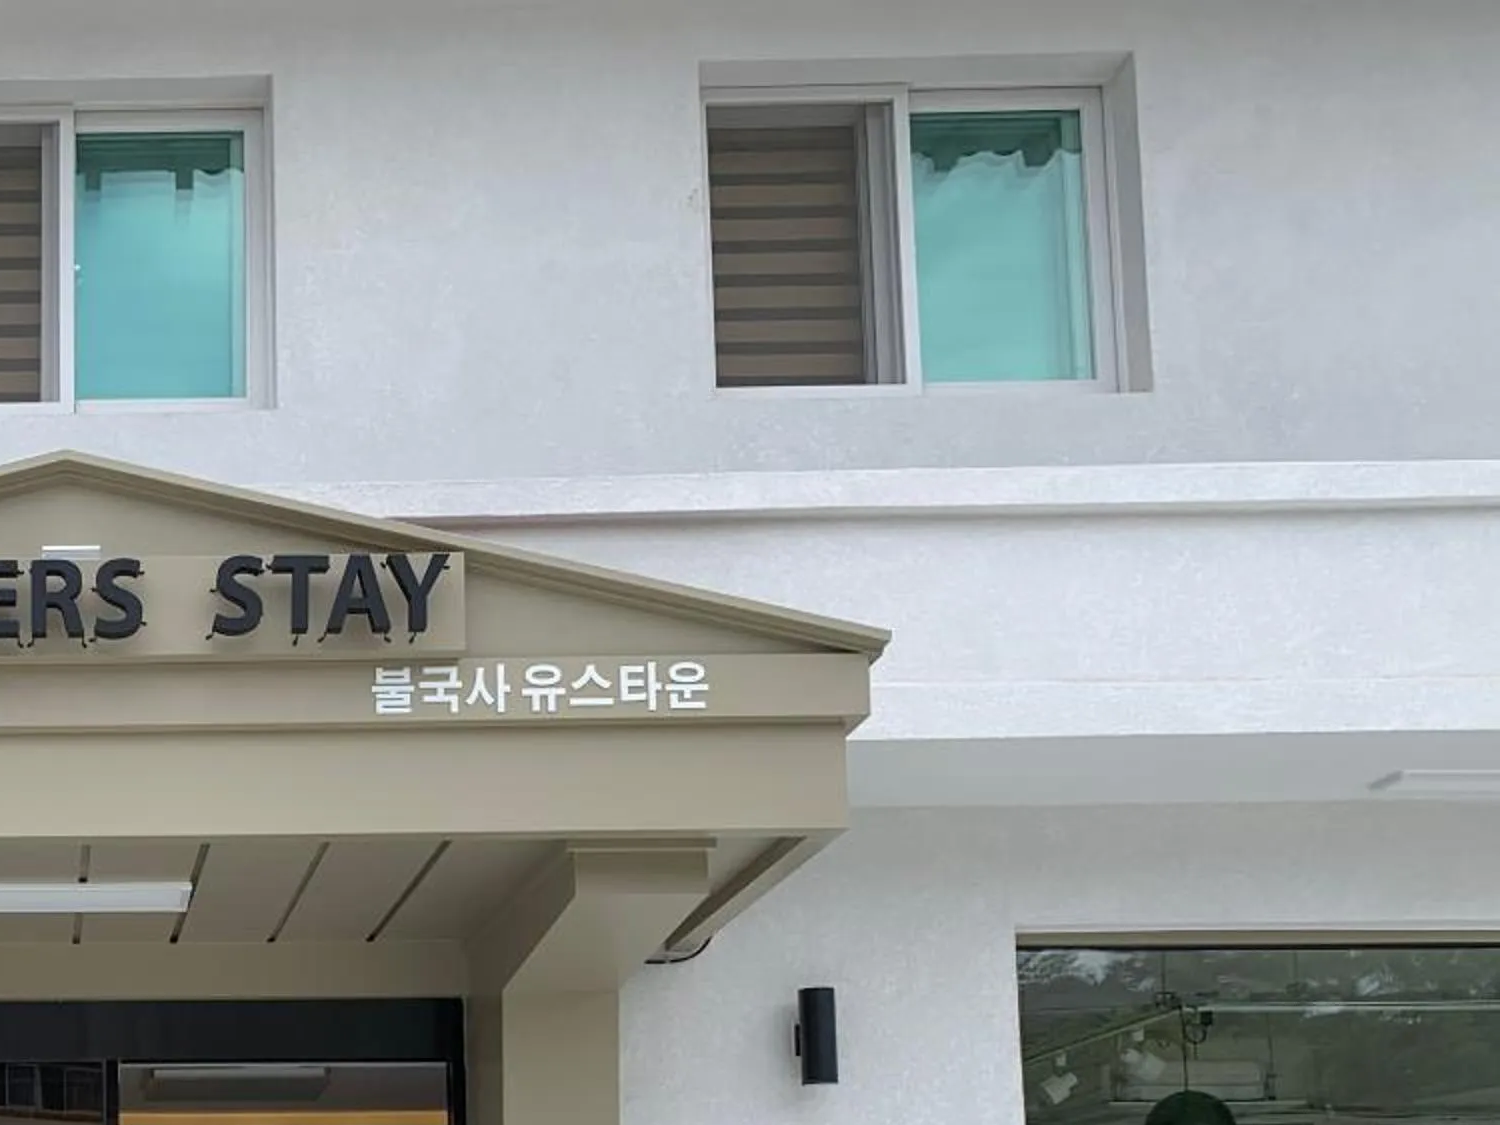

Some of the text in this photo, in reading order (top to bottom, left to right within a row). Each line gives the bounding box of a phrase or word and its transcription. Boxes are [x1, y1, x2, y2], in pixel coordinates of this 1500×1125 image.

[211, 553, 452, 638] STAY
[371, 660, 710, 715] 불국사 유스타운
